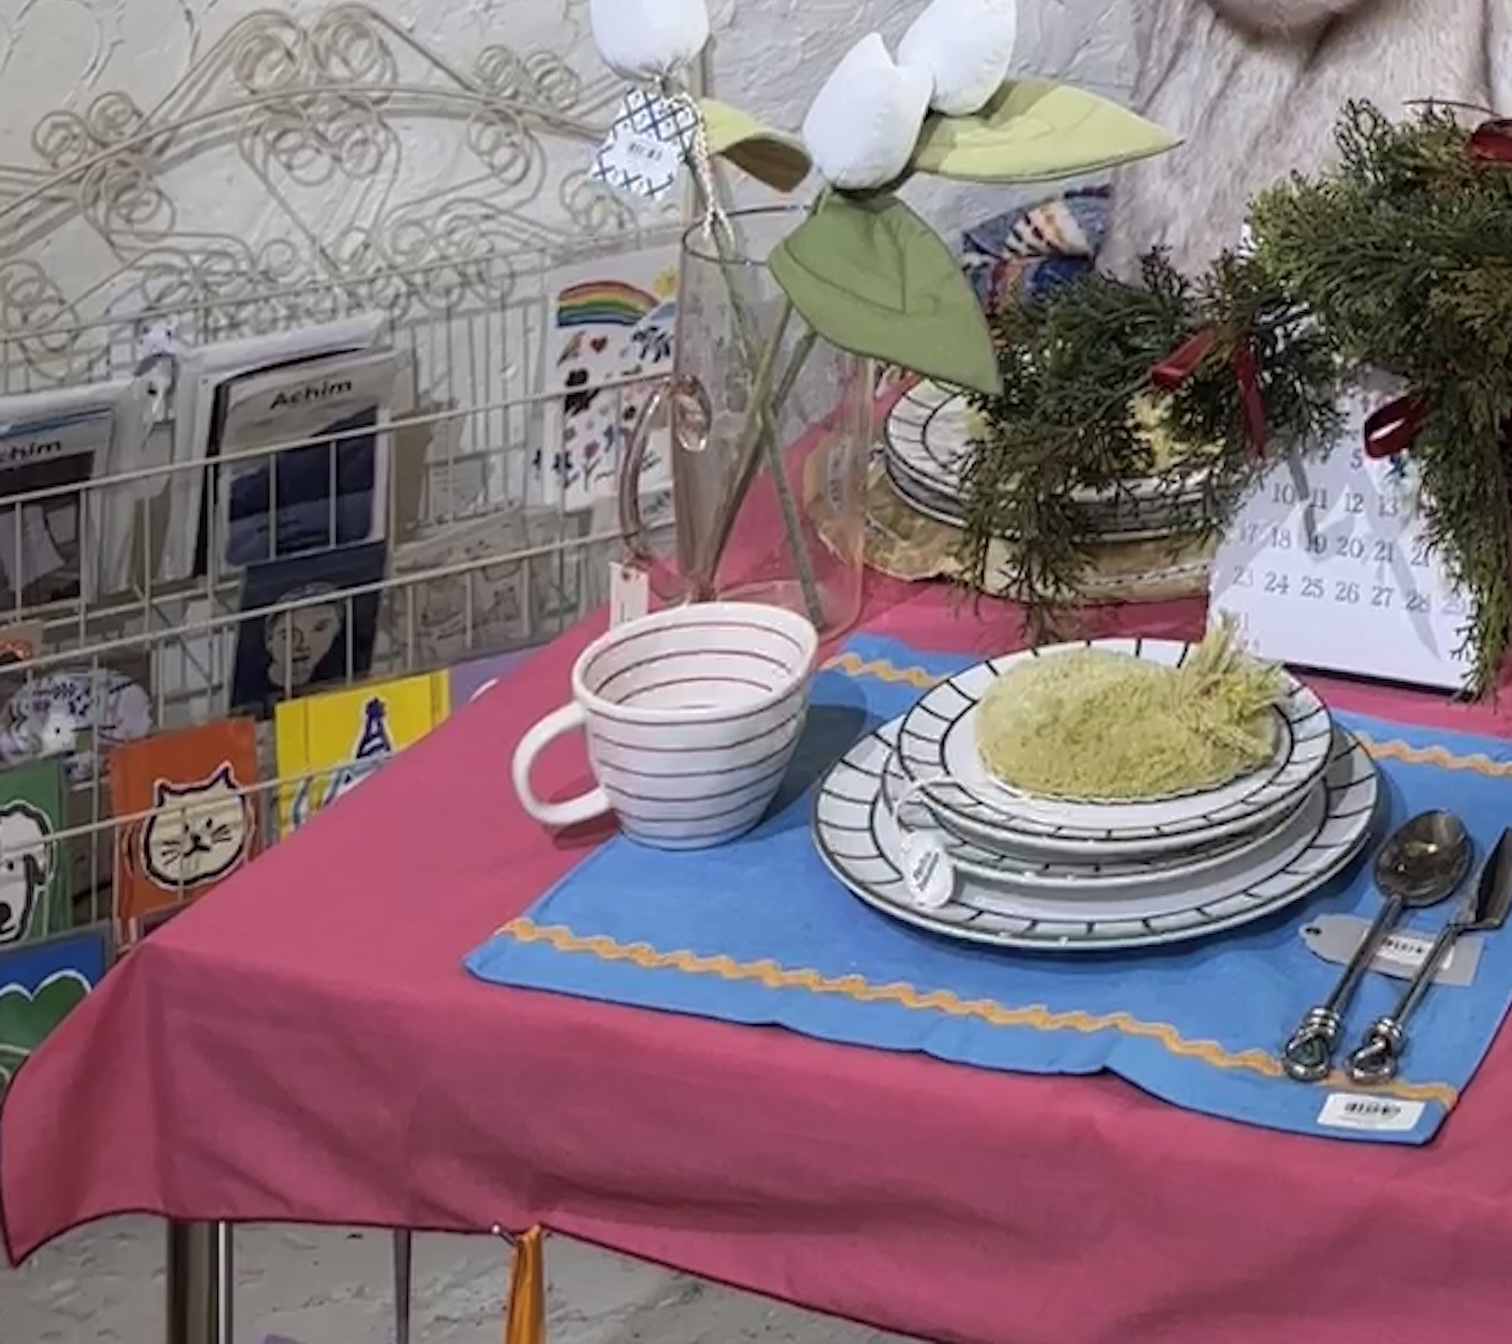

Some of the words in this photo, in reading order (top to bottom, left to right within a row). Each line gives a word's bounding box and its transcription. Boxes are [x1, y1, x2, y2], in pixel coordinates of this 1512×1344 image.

[269, 378, 353, 411] Achim
[0, 441, 61, 463] chim
[1272, 482, 1296, 506] 10
[1308, 488, 1328, 511] 11
[1344, 492, 1365, 513] 12
[1271, 526, 1291, 549] 18
[1336, 535, 1365, 559] 20
[1373, 539, 1394, 563] 21
[1263, 572, 1290, 595] 24
[1300, 576, 1325, 599] 25
[1335, 580, 1360, 604] 26
[1371, 585, 1394, 608] 27
[1405, 590, 1431, 613] 28
